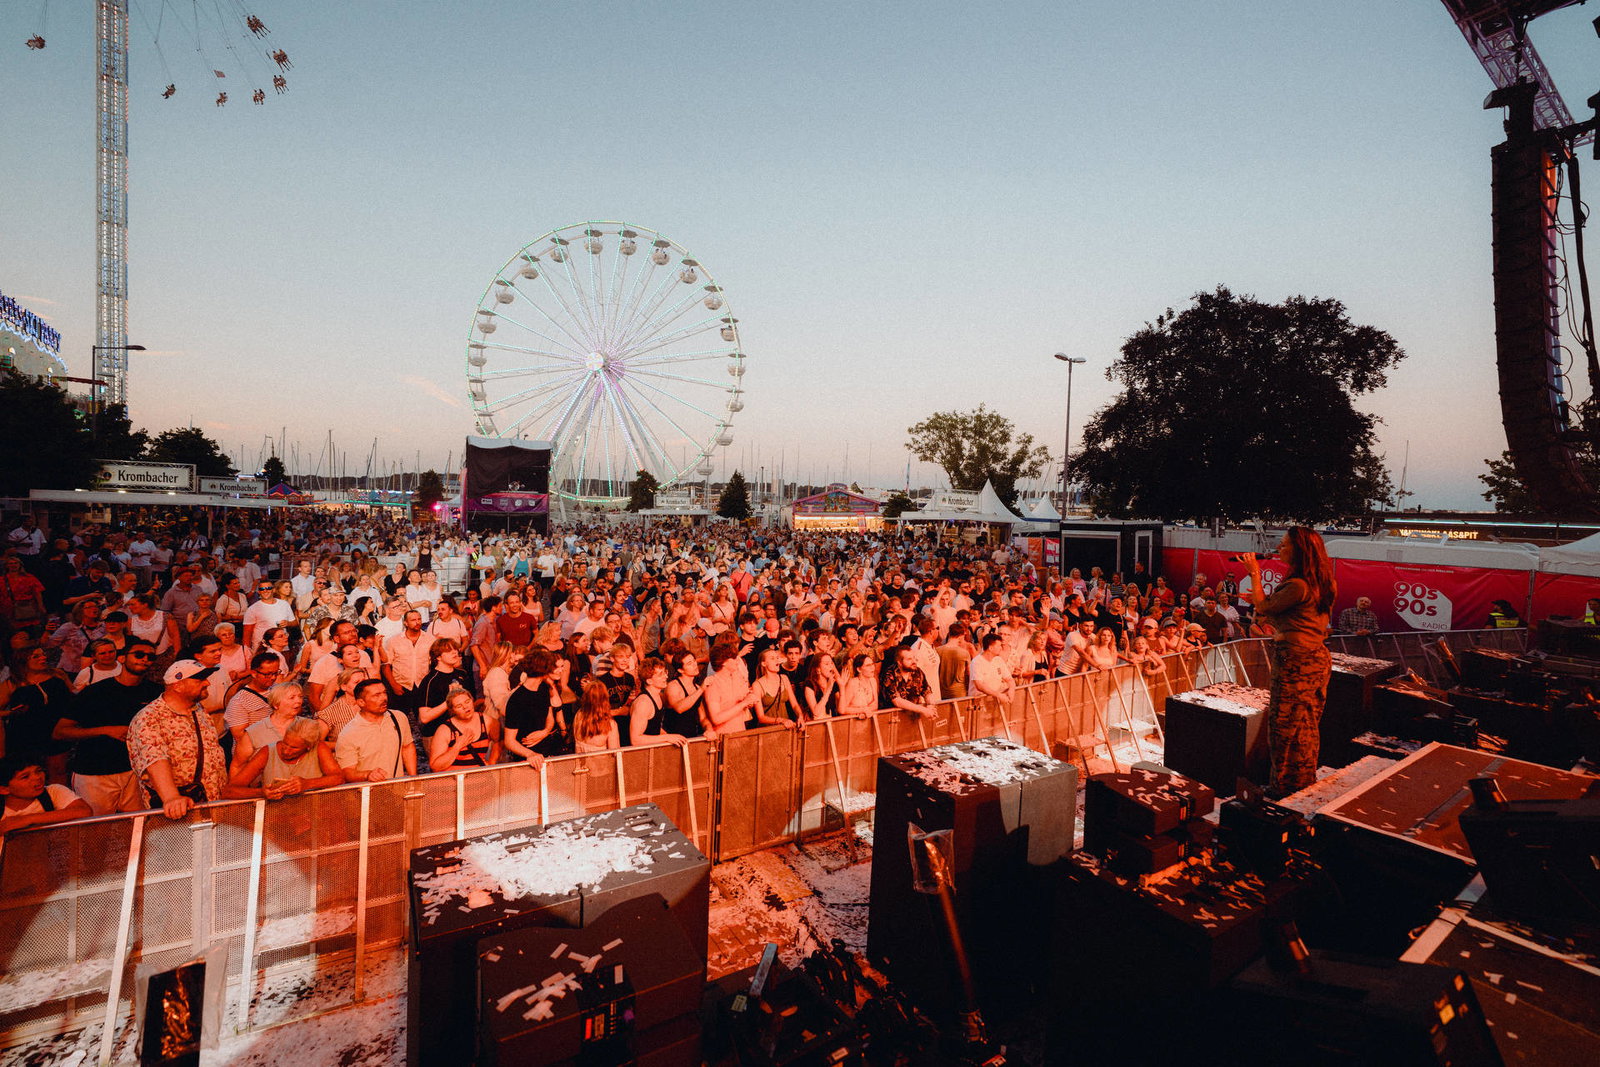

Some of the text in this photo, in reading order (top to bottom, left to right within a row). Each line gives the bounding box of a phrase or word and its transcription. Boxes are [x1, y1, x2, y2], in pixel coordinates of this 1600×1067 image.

[118, 469, 179, 484] Krombacher
[219, 482, 258, 493] Krombacher
[948, 495, 974, 506] Krombacher
[1260, 568, 1283, 584] 0s
[1394, 581, 1438, 600] 90s
[1394, 598, 1437, 616] 90s
[1422, 621, 1448, 630] RADIO
